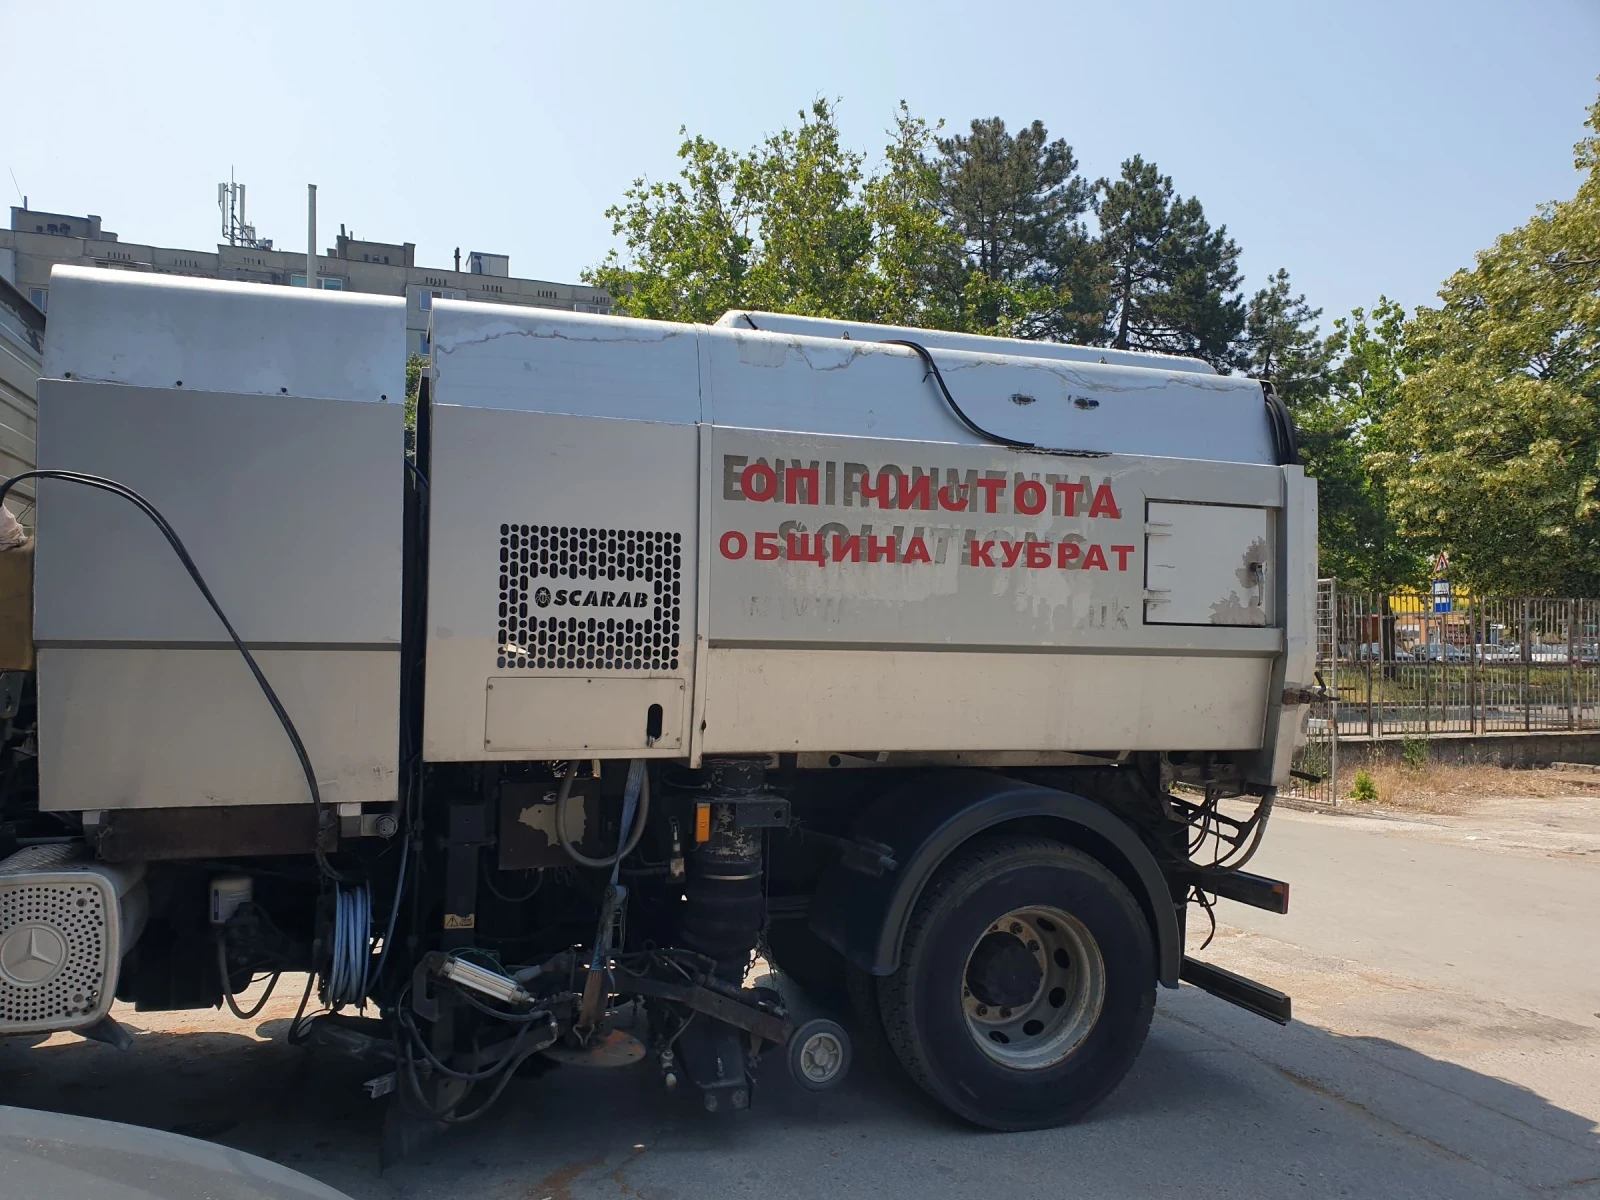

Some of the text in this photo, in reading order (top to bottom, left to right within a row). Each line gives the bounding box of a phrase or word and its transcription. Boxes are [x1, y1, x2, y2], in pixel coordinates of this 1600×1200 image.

[740, 464, 819, 505] ОП
[719, 531, 1135, 571] ОБЩИНА КУБРАТ
[553, 589, 648, 607] SCARAB
